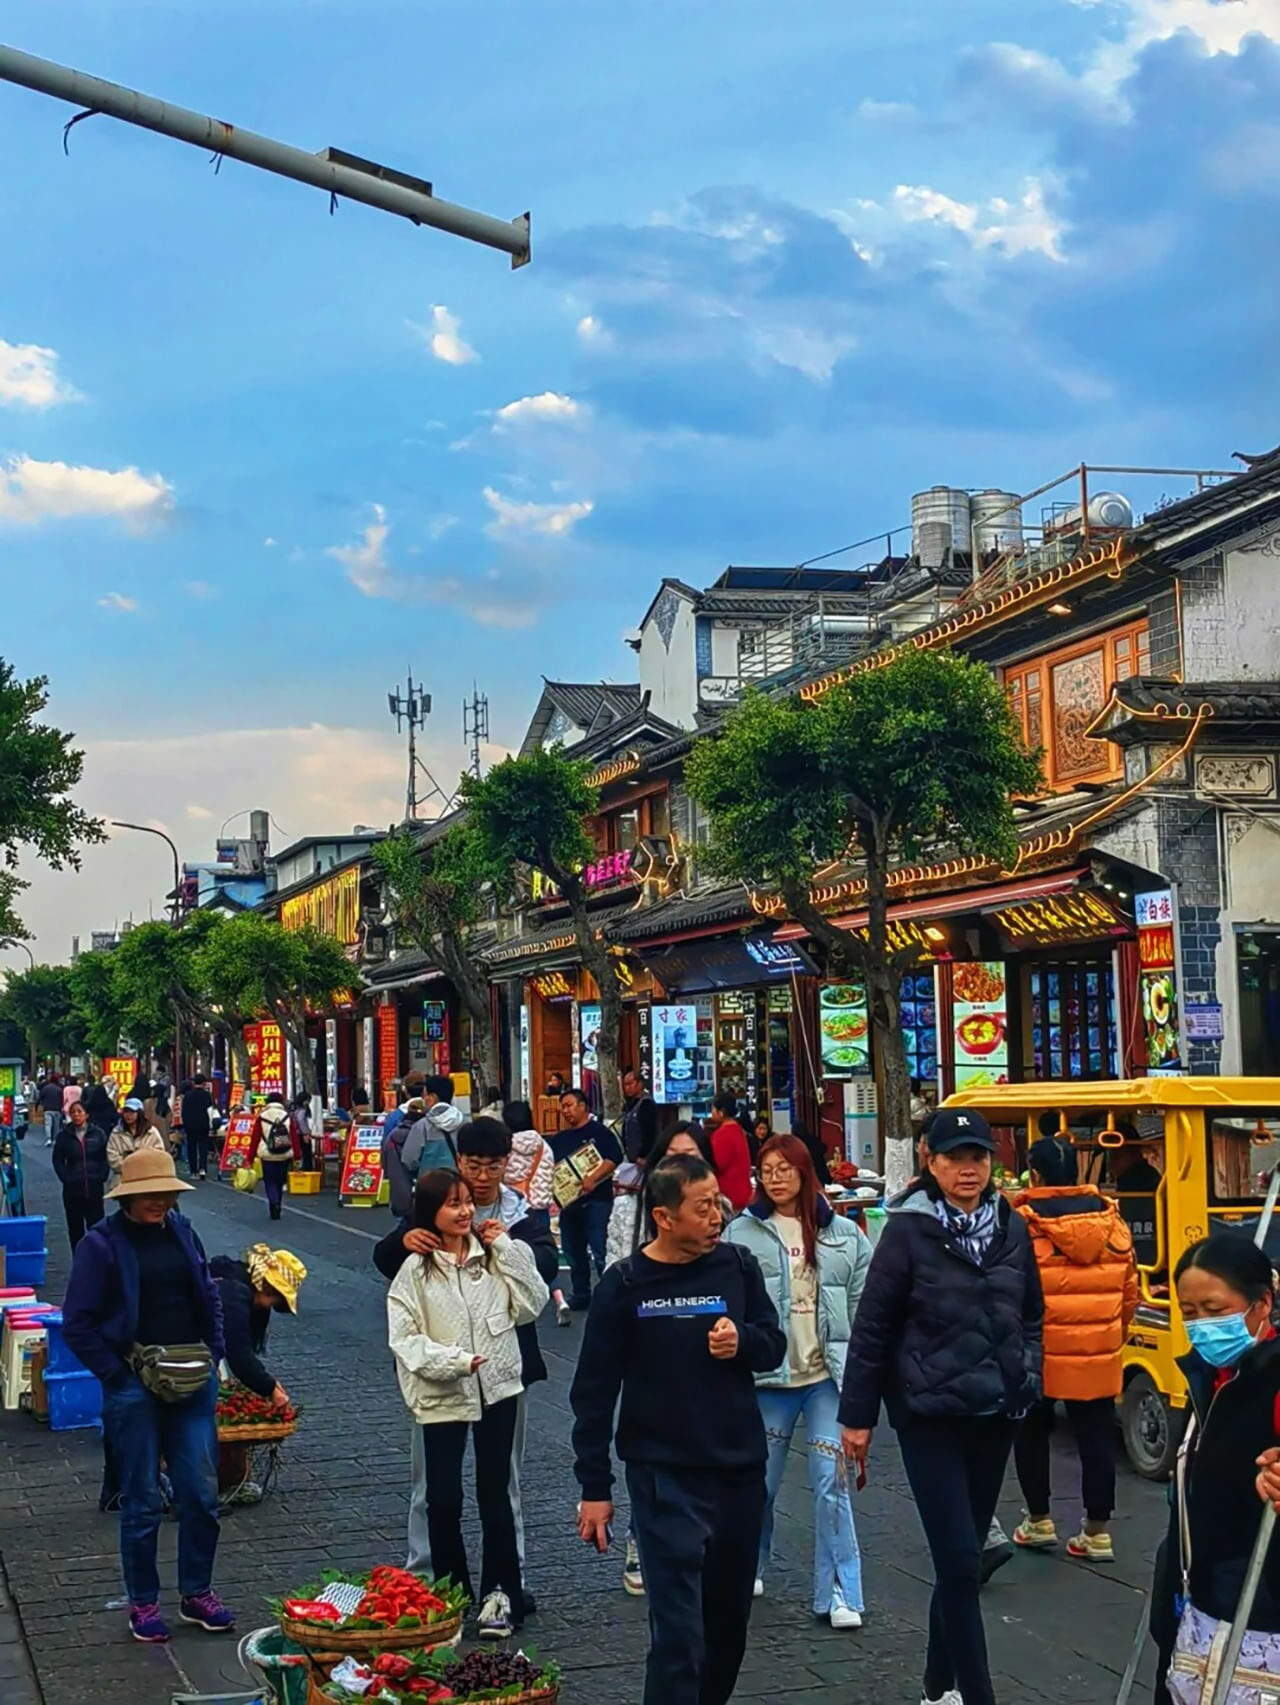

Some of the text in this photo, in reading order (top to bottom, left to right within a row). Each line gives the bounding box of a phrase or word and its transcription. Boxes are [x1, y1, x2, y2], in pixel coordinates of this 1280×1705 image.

[427, 1004, 443, 1037] 超市
[658, 1008, 688, 1024] 寸家
[262, 1024, 281, 1080] 四川泸州
[957, 1116, 970, 1126] R
[642, 1295, 721, 1309] HIGH ENERGY
